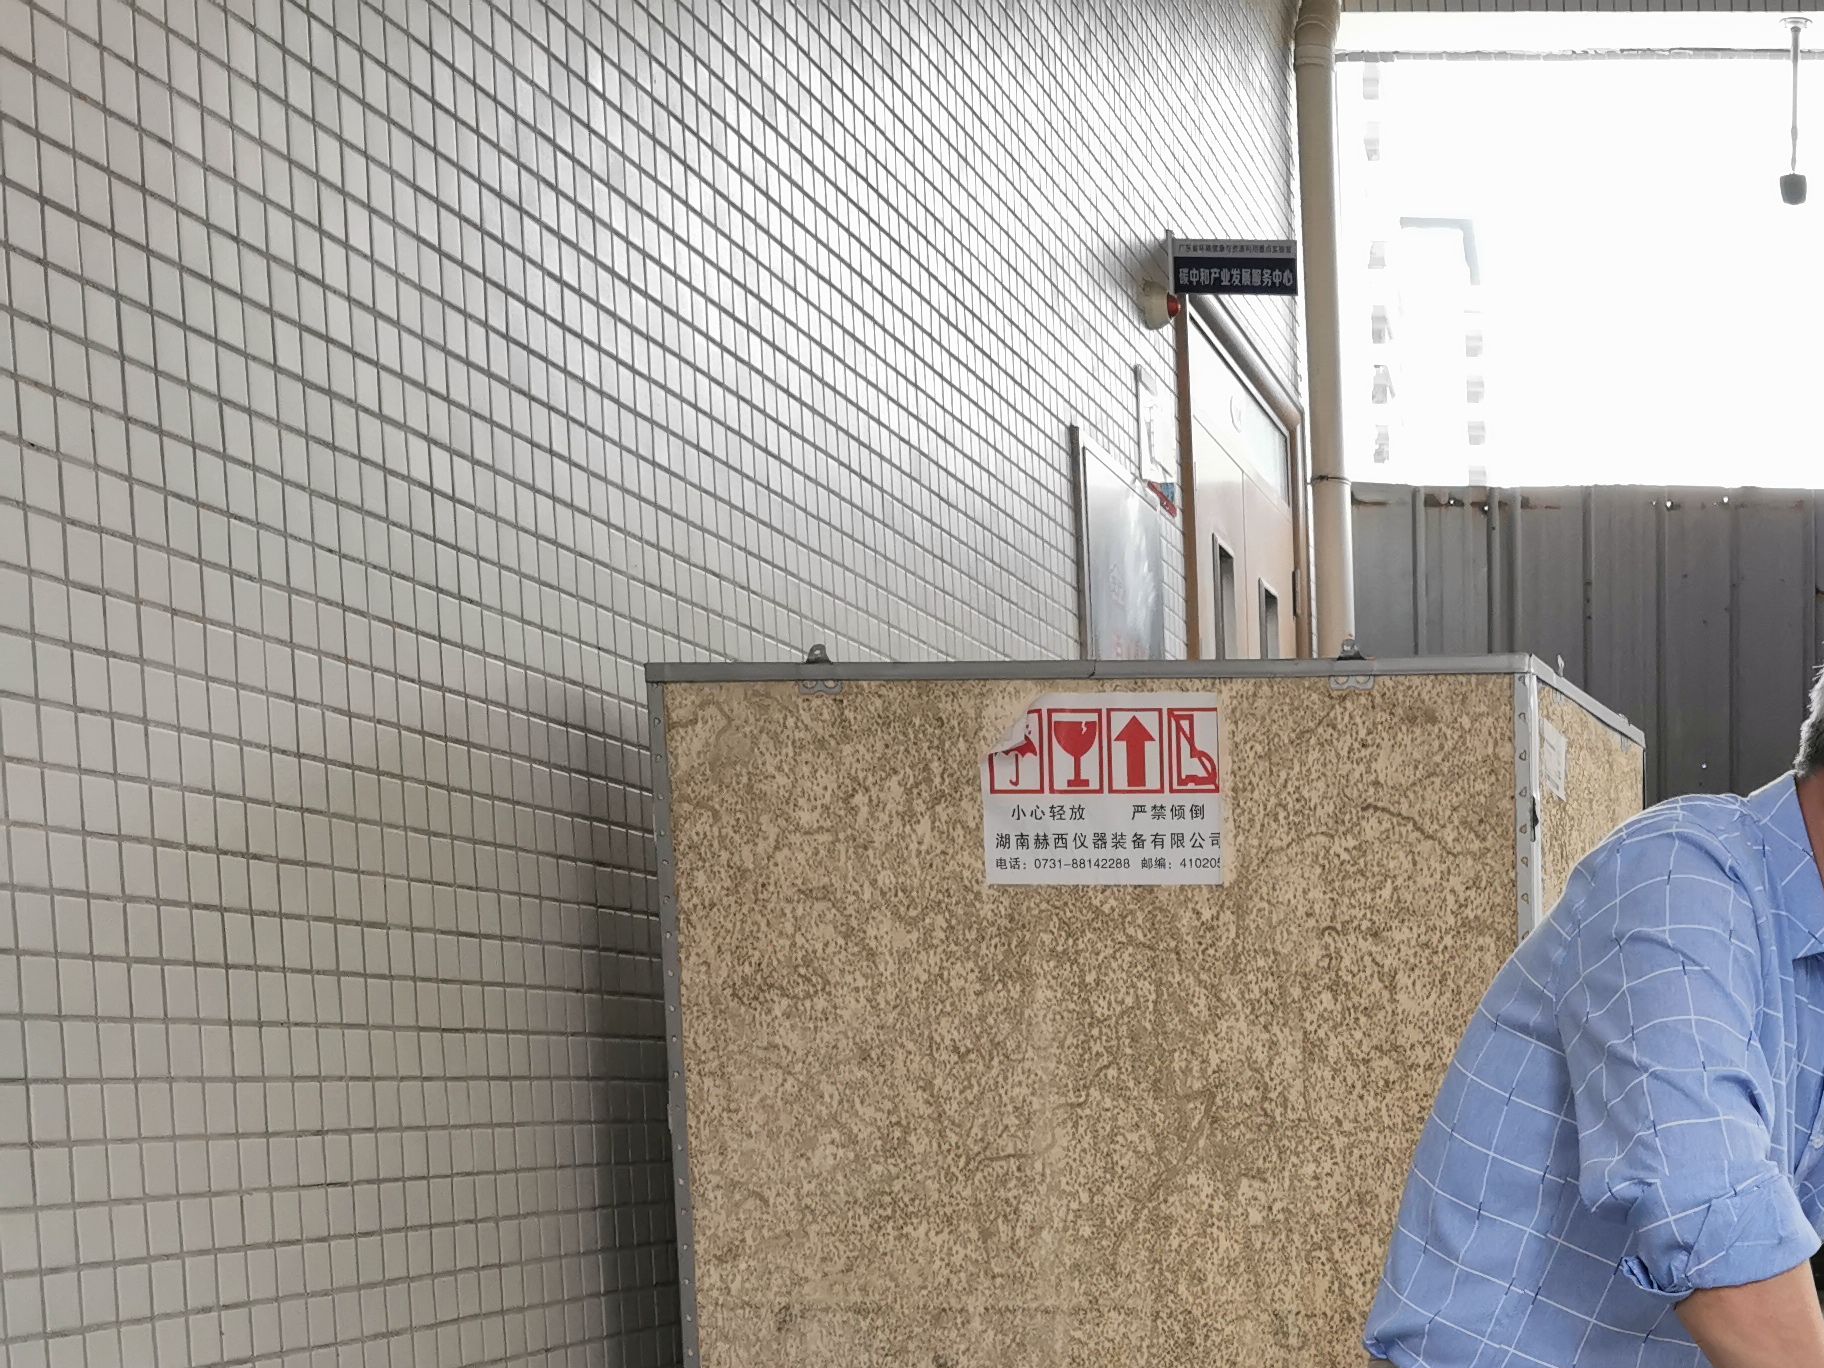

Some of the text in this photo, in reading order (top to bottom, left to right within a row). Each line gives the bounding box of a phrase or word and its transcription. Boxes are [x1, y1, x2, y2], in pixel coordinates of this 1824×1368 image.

[1179, 267, 1294, 287] 碳中和产业发展服务中心
[1011, 803, 1205, 821] 小心轻放 严禁倾倒
[995, 831, 1221, 850] 湖南赫西仪器装备有限公司
